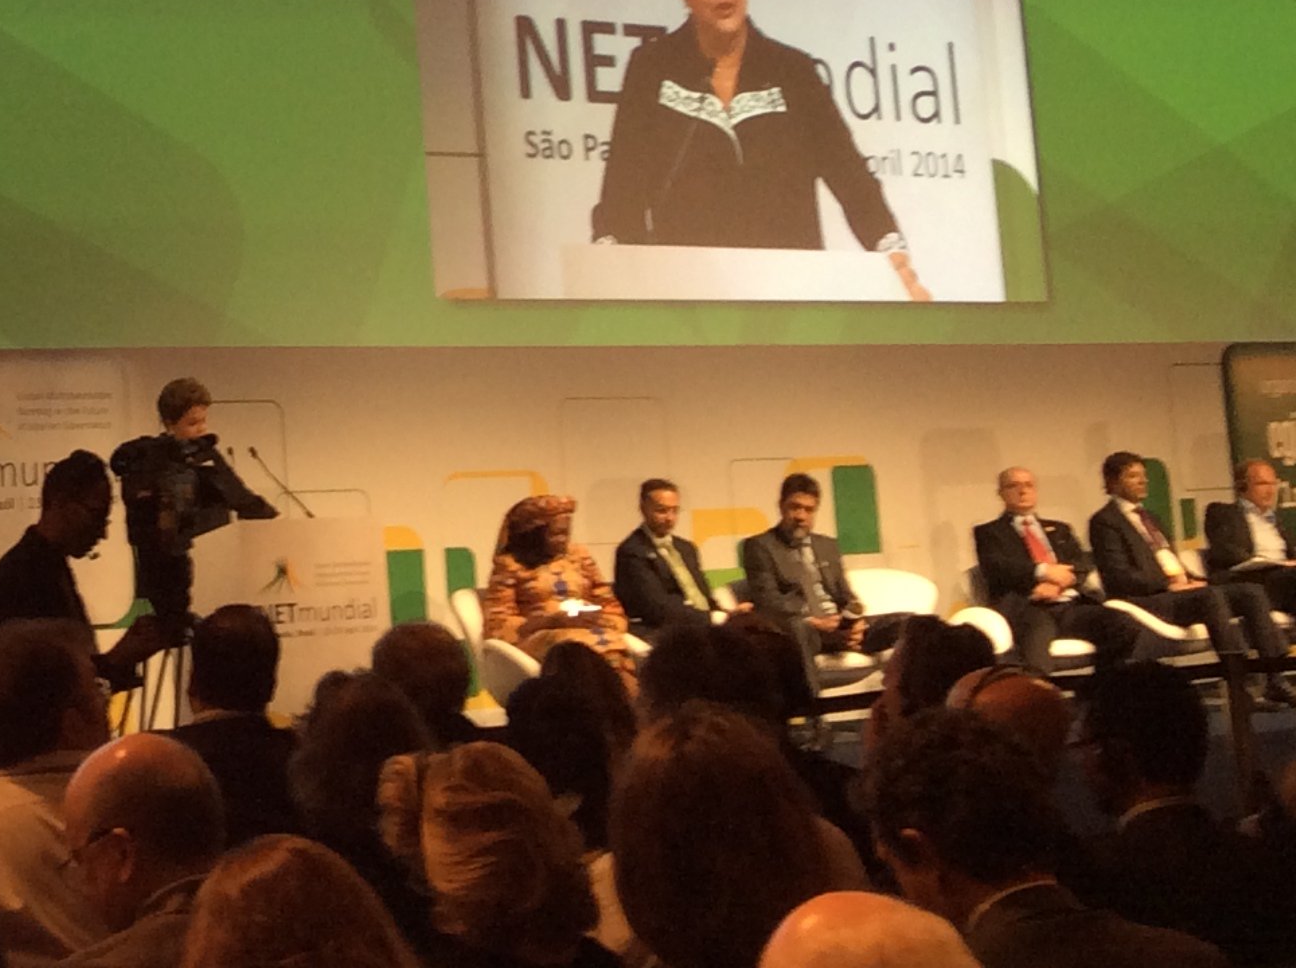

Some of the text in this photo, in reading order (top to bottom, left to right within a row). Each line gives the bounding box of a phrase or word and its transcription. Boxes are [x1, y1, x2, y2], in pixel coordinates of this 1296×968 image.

[524, 130, 574, 161] São
[864, 149, 903, 177] pril
[910, 150, 966, 179] 2014
